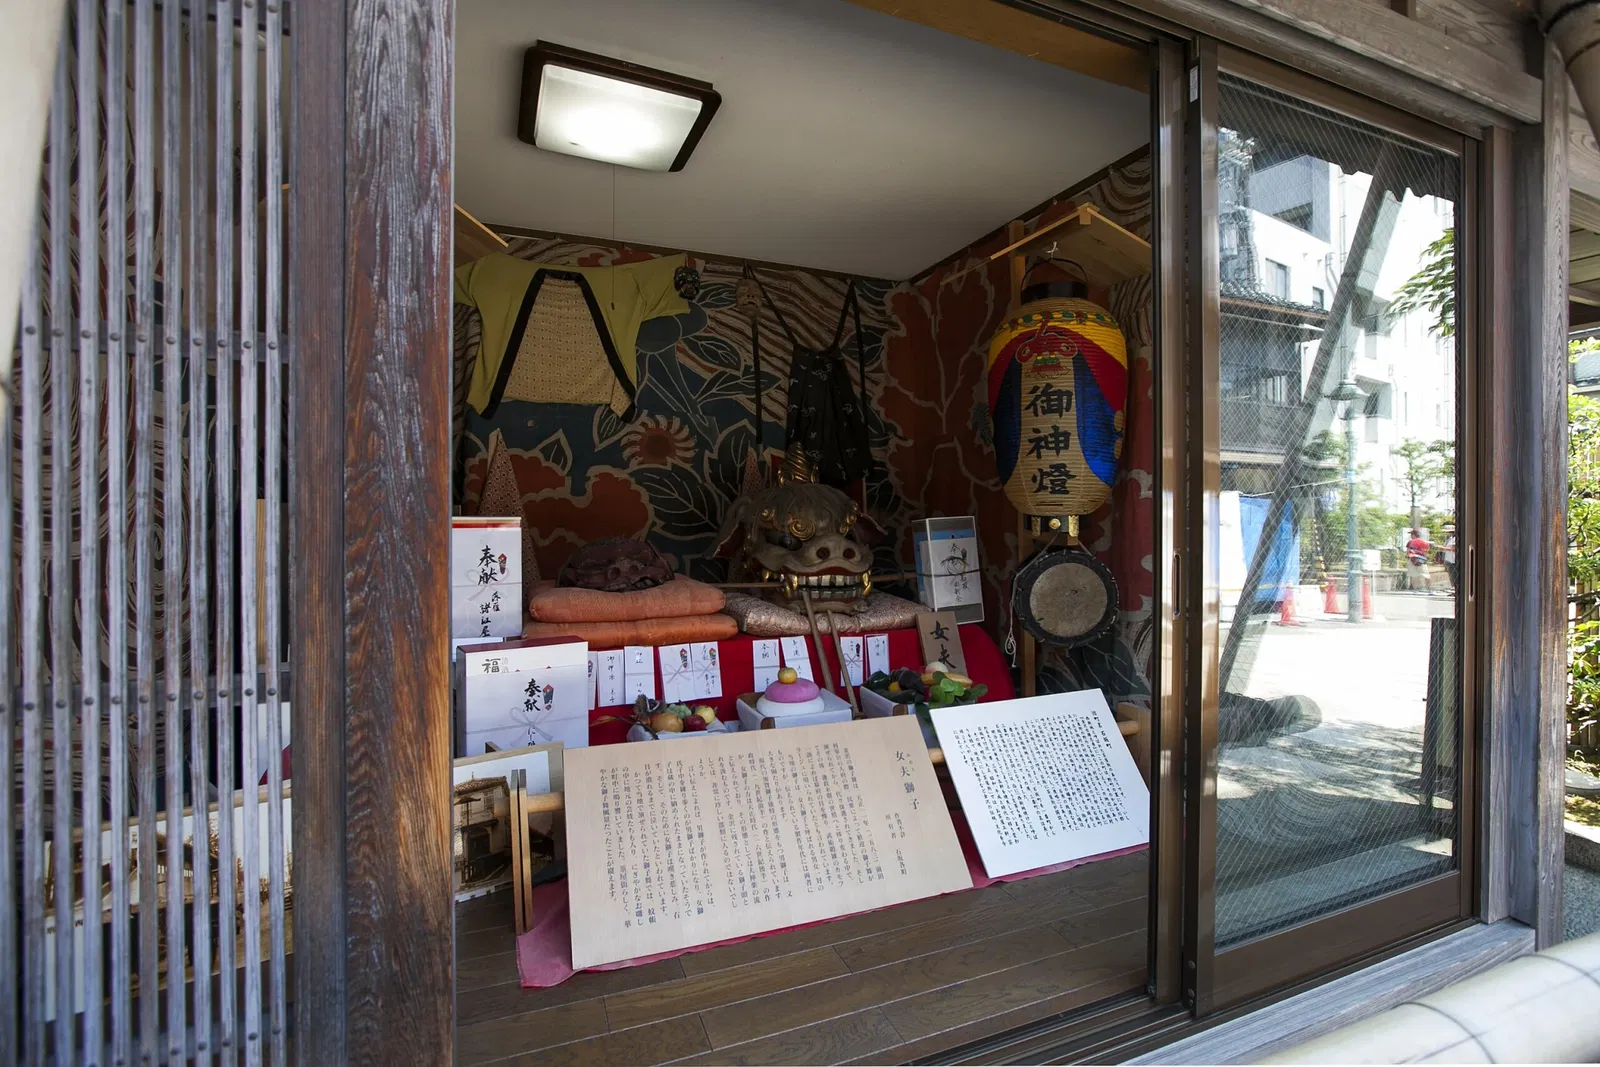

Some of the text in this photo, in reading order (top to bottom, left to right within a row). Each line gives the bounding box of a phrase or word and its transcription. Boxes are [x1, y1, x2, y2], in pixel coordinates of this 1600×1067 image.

[1025, 383, 1076, 495] 御神燈
[477, 545, 498, 585] 奉献
[481, 657, 502, 674] 福
[522, 678, 542, 713] 奉献
[1099, 730, 1112, 748] 石坂町
[896, 751, 919, 809] 女夫獅子
